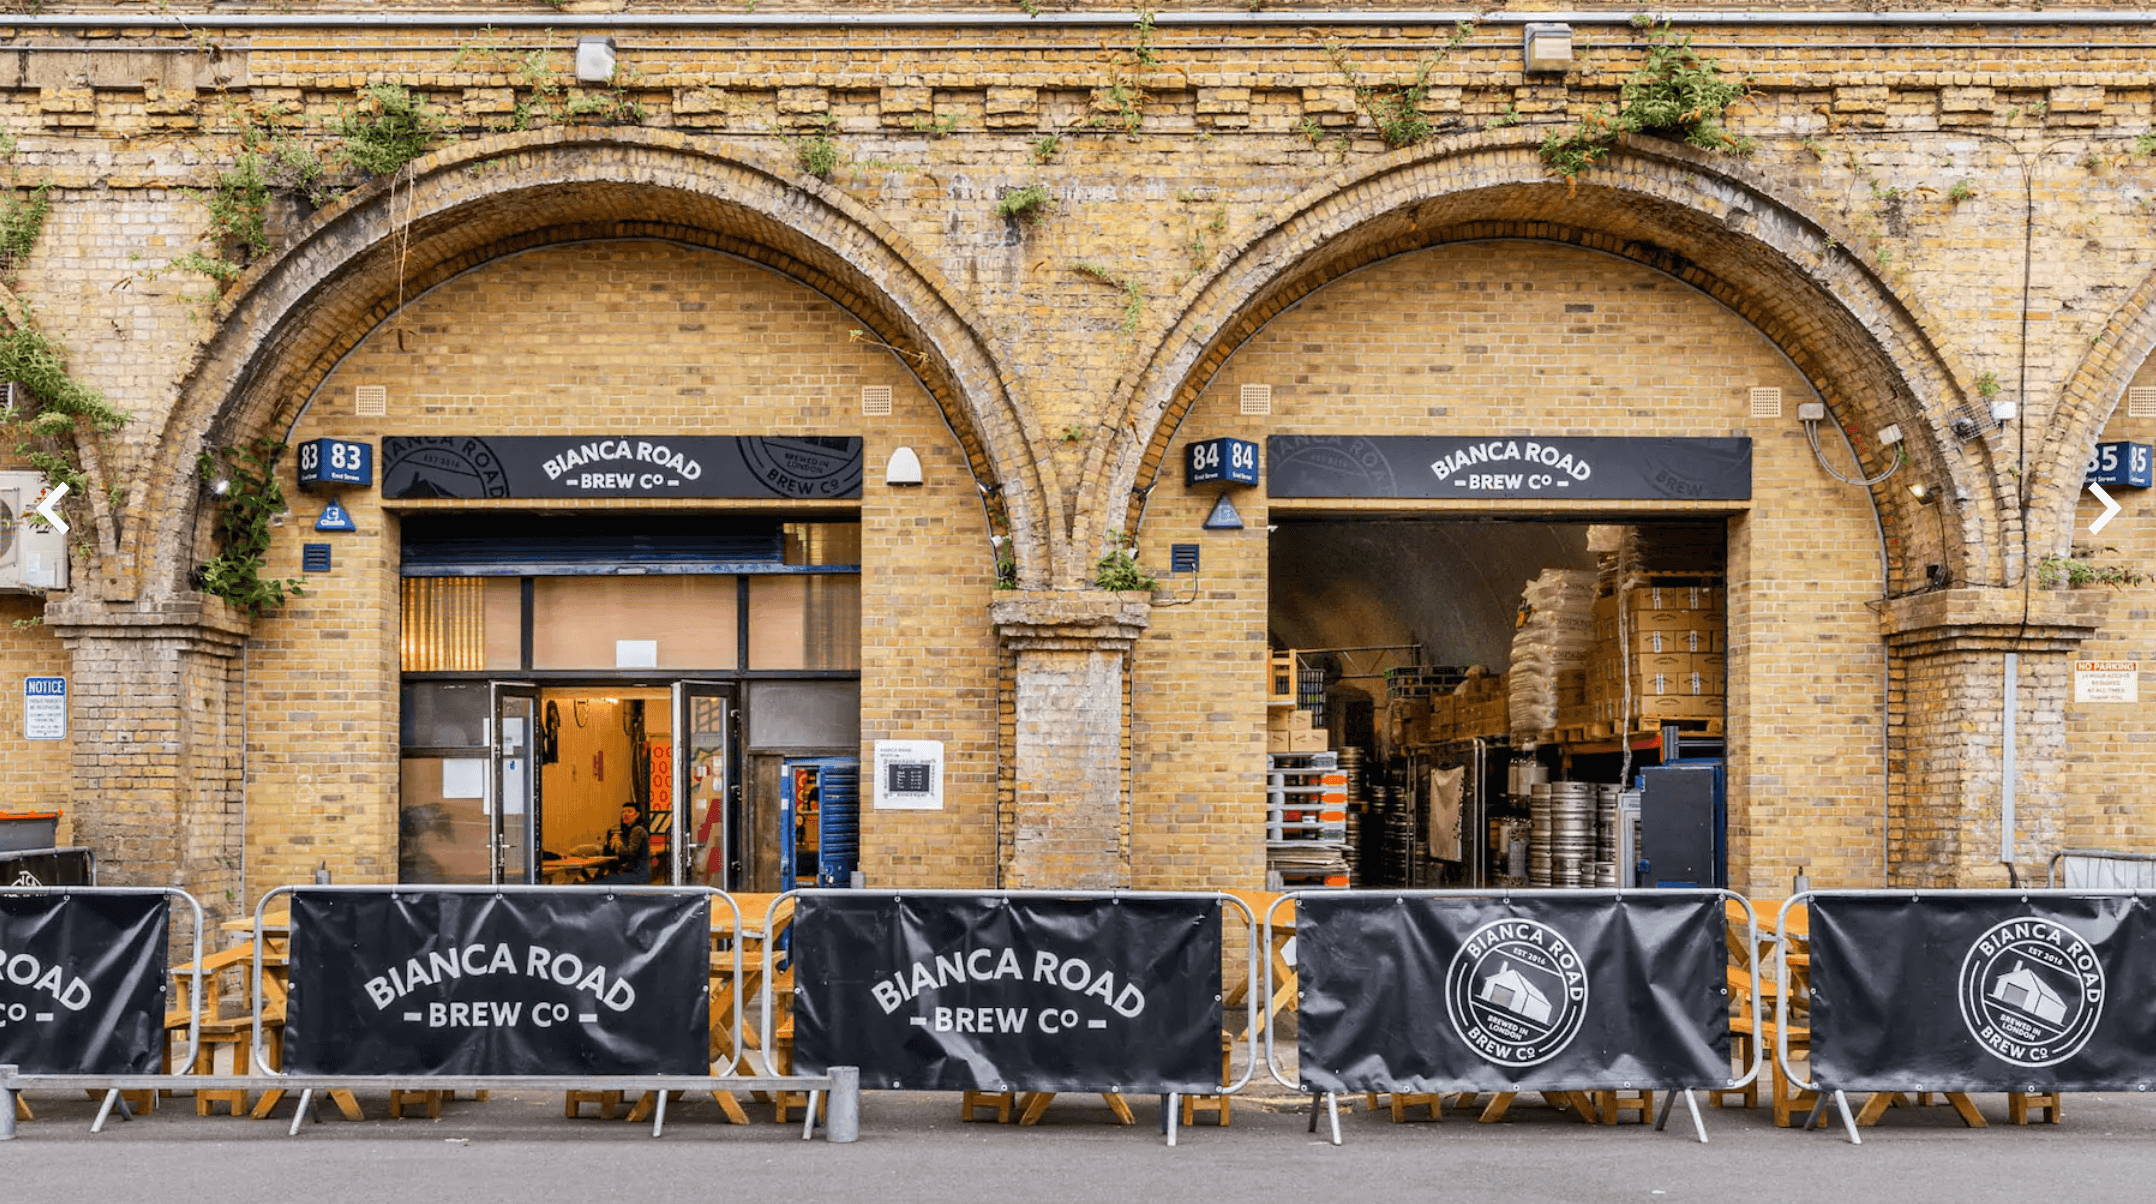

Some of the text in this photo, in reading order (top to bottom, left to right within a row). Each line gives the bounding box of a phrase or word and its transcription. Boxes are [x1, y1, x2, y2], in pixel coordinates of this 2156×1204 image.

[301, 444, 318, 470] 83
[331, 443, 361, 470] 83
[542, 440, 701, 480] BIANCA ROAD
[1193, 443, 1220, 470] 84
[1232, 442, 1253, 469] 84
[1430, 440, 1591, 481] BIANCA ROAD
[2131, 446, 2147, 472] 85
[581, 473, 635, 489] BREW
[767, 468, 814, 494] BREW
[1469, 474, 1524, 490] BREW
[2077, 662, 2134, 671] NO PARKING
[28, 680, 63, 694] NOTICE
[1467, 924, 1584, 1001] BIANCA ROAD
[1513, 948, 1547, 966] EST 2016
[1979, 923, 2101, 1003] BIANCA ROAD
[2028, 947, 2064, 966] EST 2016
[363, 943, 637, 1012] BIANCA ROAD
[870, 947, 1146, 1019] BIANCA ROAD
[429, 1001, 522, 1028] BREW
[935, 1007, 1028, 1033] BREW
[1487, 1014, 1529, 1036] BREWED IN
[2000, 1014, 2042, 1037] BREWED IN
[1467, 1026, 1512, 1059] BREW
[1488, 1023, 1523, 1041] LONDON
[1981, 1025, 2026, 1059] BREW
[2001, 1022, 2036, 1041] LONDON
